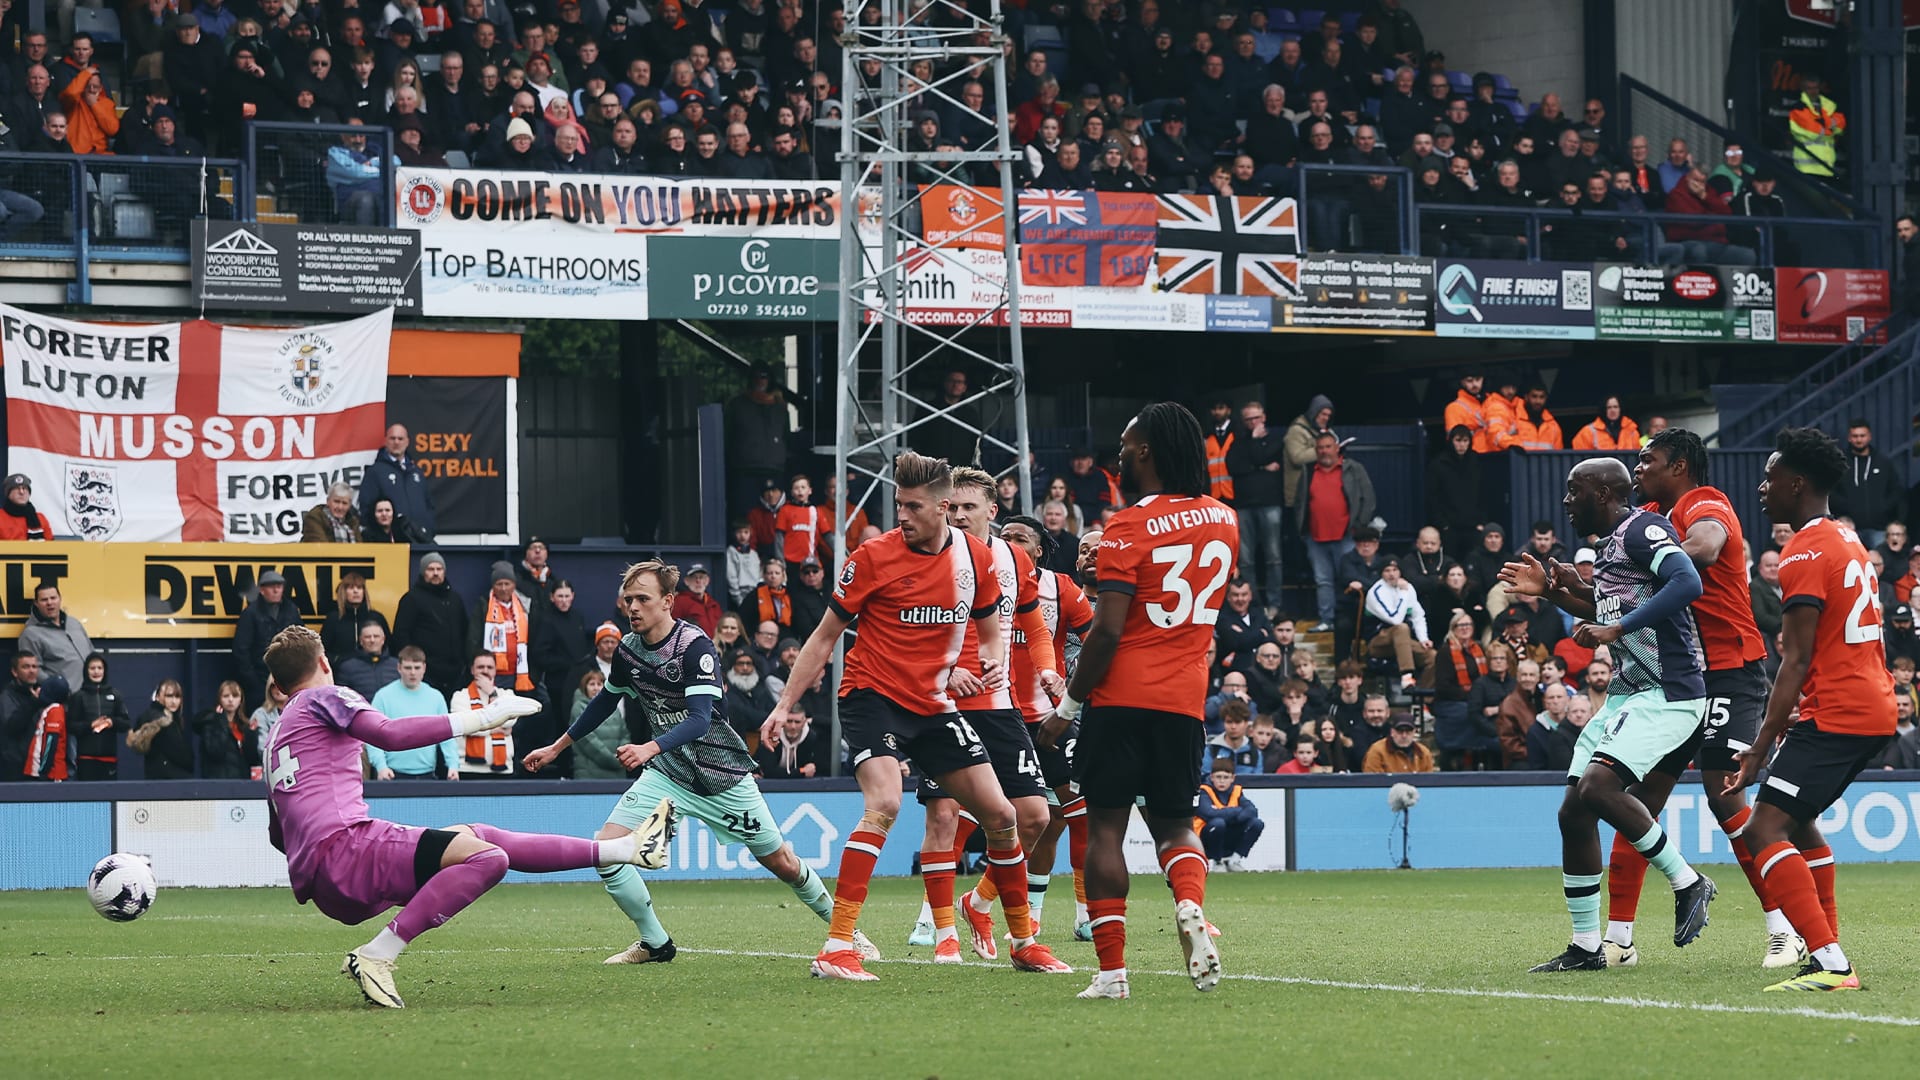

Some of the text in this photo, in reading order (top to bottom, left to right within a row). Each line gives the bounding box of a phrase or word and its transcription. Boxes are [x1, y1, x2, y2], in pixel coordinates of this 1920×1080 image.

[451, 178, 835, 227] COME ON YOU HATTERS
[297, 232, 413, 246] FOR ALL YOUR BUILDING NEEDS
[1024, 229, 1042, 240] WE
[1046, 229, 1067, 240] ARE
[1070, 229, 1115, 241] PREMIER
[207, 254, 279, 266] WOODBURY HILL
[424, 247, 641, 282] TOP BATHROOMS
[971, 251, 1002, 264] Sales
[1028, 253, 1078, 274] LTFC
[1302, 260, 1433, 275] ousTime Cleaning Services
[207, 265, 279, 277] CONSTRUCTION
[1482, 277, 1558, 296] FINE FINISH
[1623, 278, 1665, 290] Windows
[971, 291, 1054, 304] Manement
[1480, 296, 1557, 306] DECORATORS
[1632, 291, 1660, 301] Doors
[708, 303, 807, 317] 07719 325410
[3, 315, 170, 362] FOREVER
[22, 360, 147, 400] LUTON
[79, 414, 316, 459] MUSSON
[415, 433, 472, 453] SEXY
[416, 457, 499, 478] OTBALL
[227, 465, 368, 500] FOREVE
[228, 510, 304, 535] ENG
[1146, 540, 1232, 629] 32
[900, 604, 954, 625] utilita
[1704, 697, 1731, 728] 15
[946, 717, 980, 746] 16
[722, 811, 760, 832] 24
